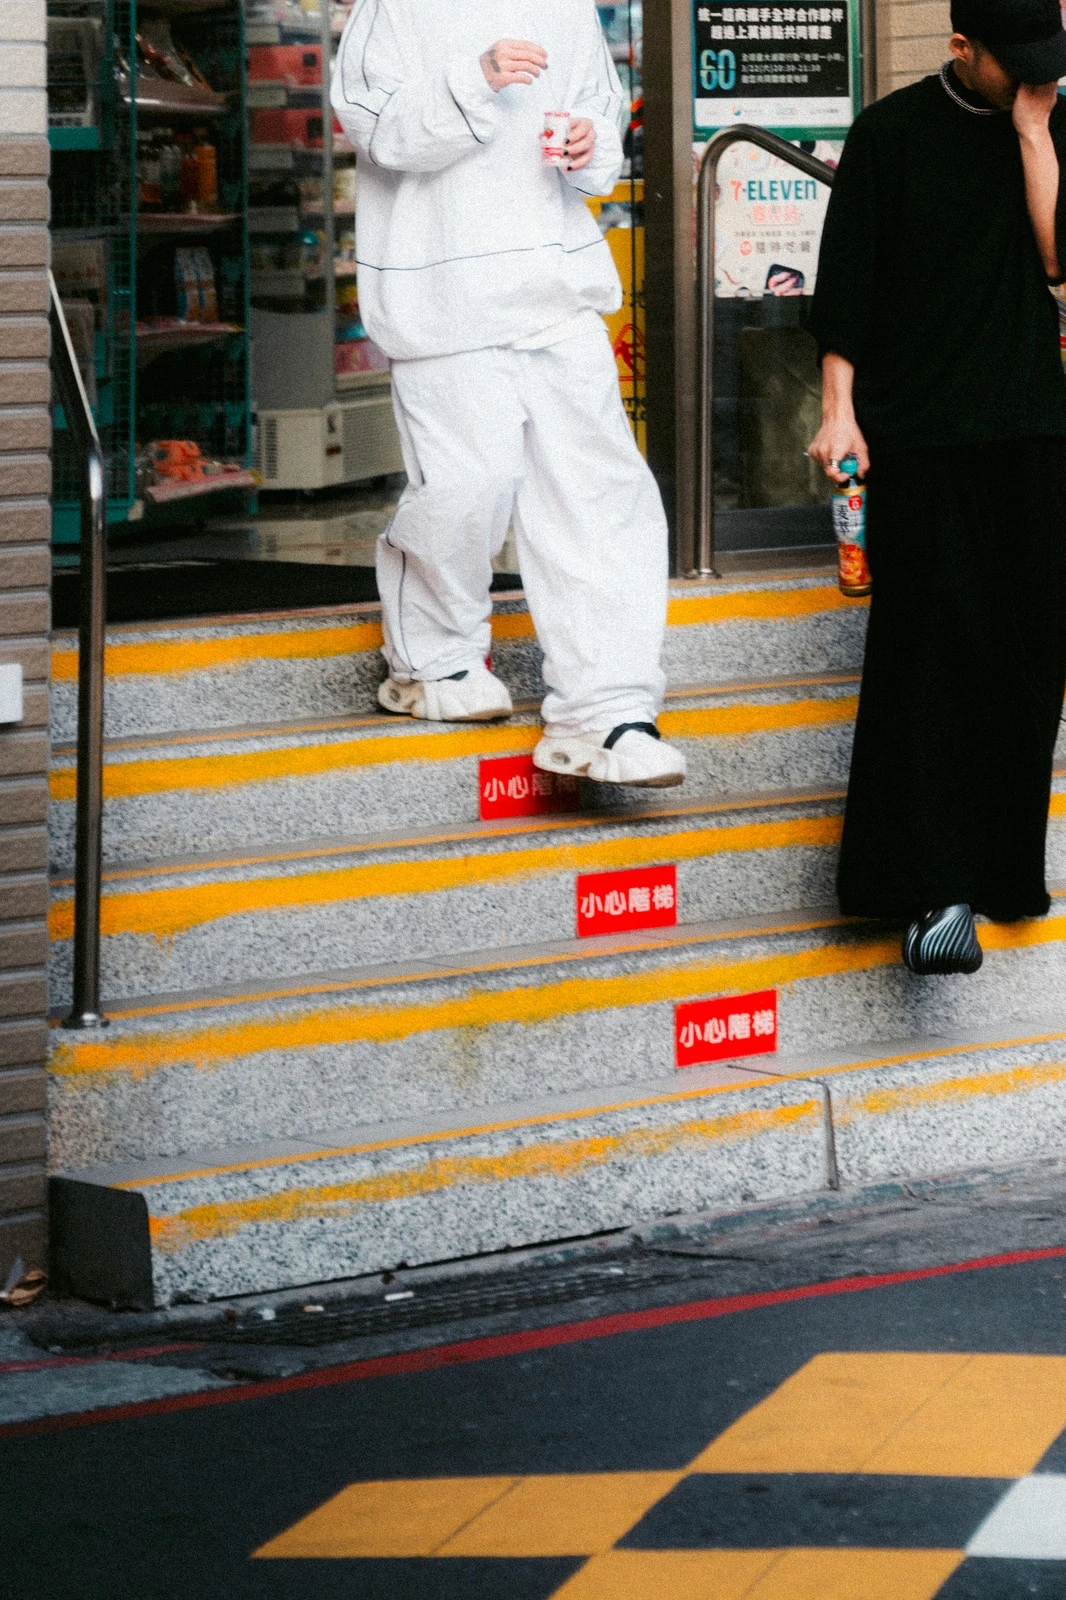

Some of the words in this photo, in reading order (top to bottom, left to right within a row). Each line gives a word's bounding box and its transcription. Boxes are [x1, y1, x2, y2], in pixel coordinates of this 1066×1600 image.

[700, 49, 736, 90] 60
[580, 884, 675, 918] 小心階梯
[679, 1009, 776, 1048] 小心階梯
